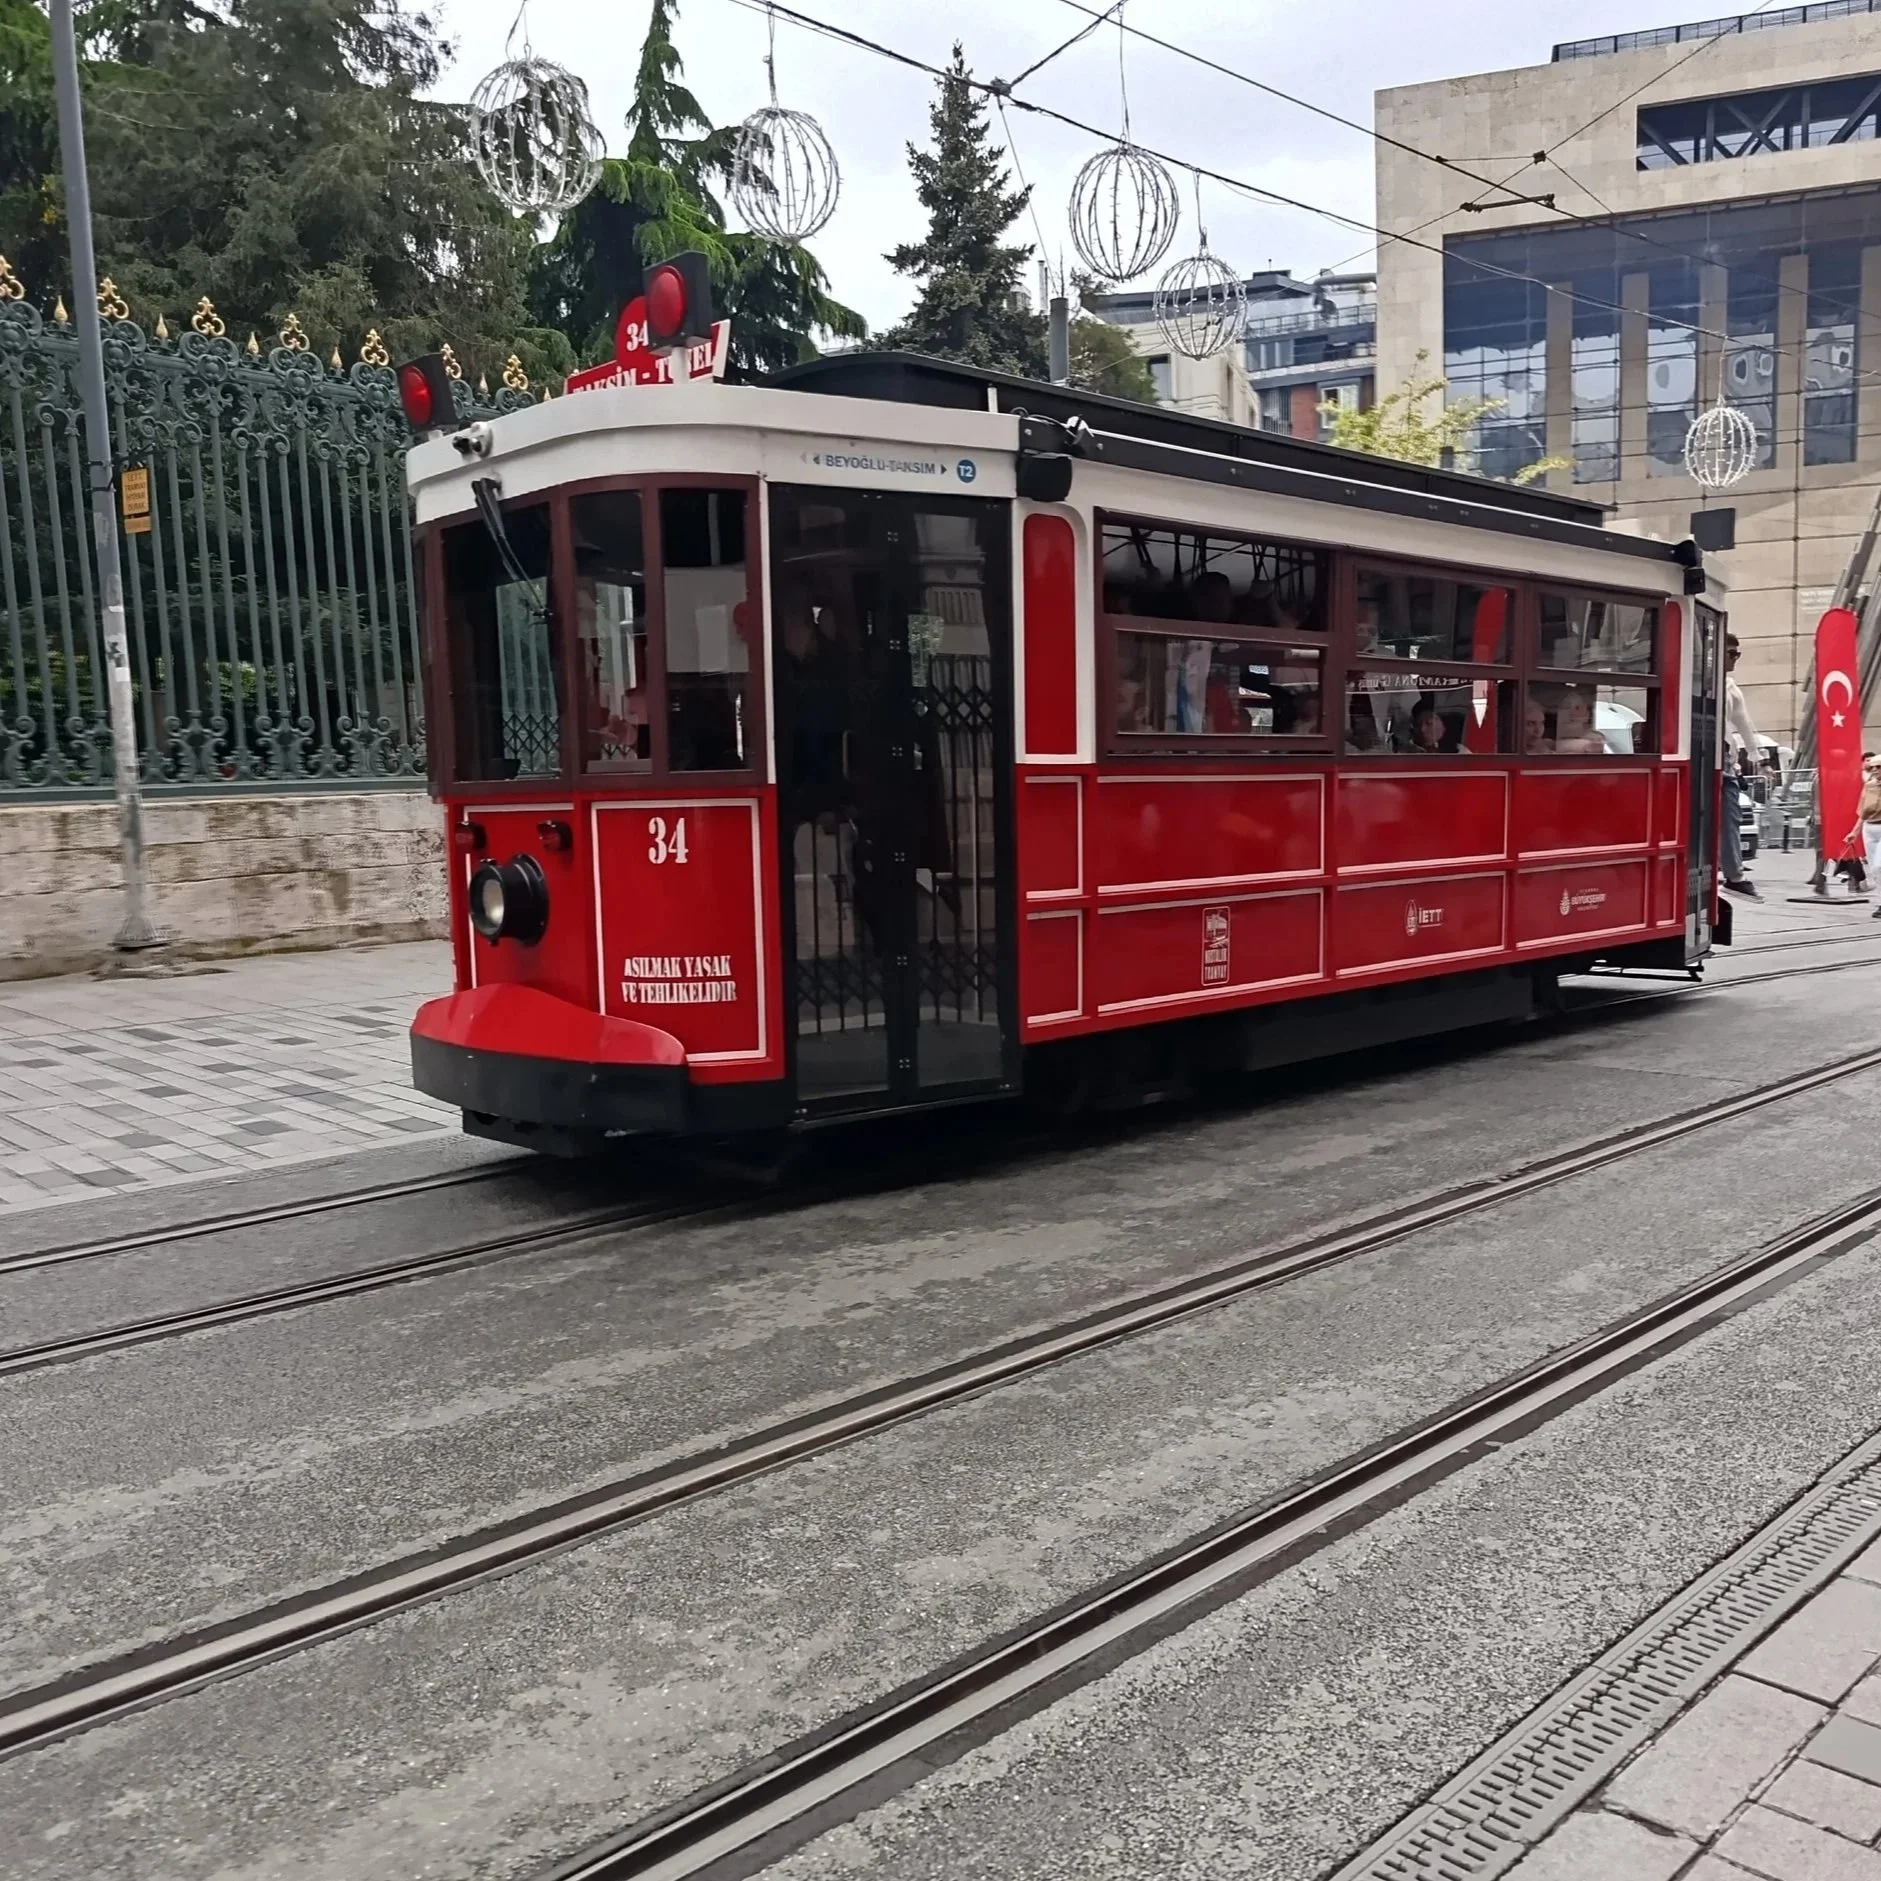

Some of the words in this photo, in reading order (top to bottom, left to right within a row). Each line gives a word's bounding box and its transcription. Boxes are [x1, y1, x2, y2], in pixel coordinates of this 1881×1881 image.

[648, 816, 689, 864] 34
[624, 956, 682, 978] ASILMAK
[683, 955, 732, 978] YASAK
[621, 981, 638, 1003] VE
